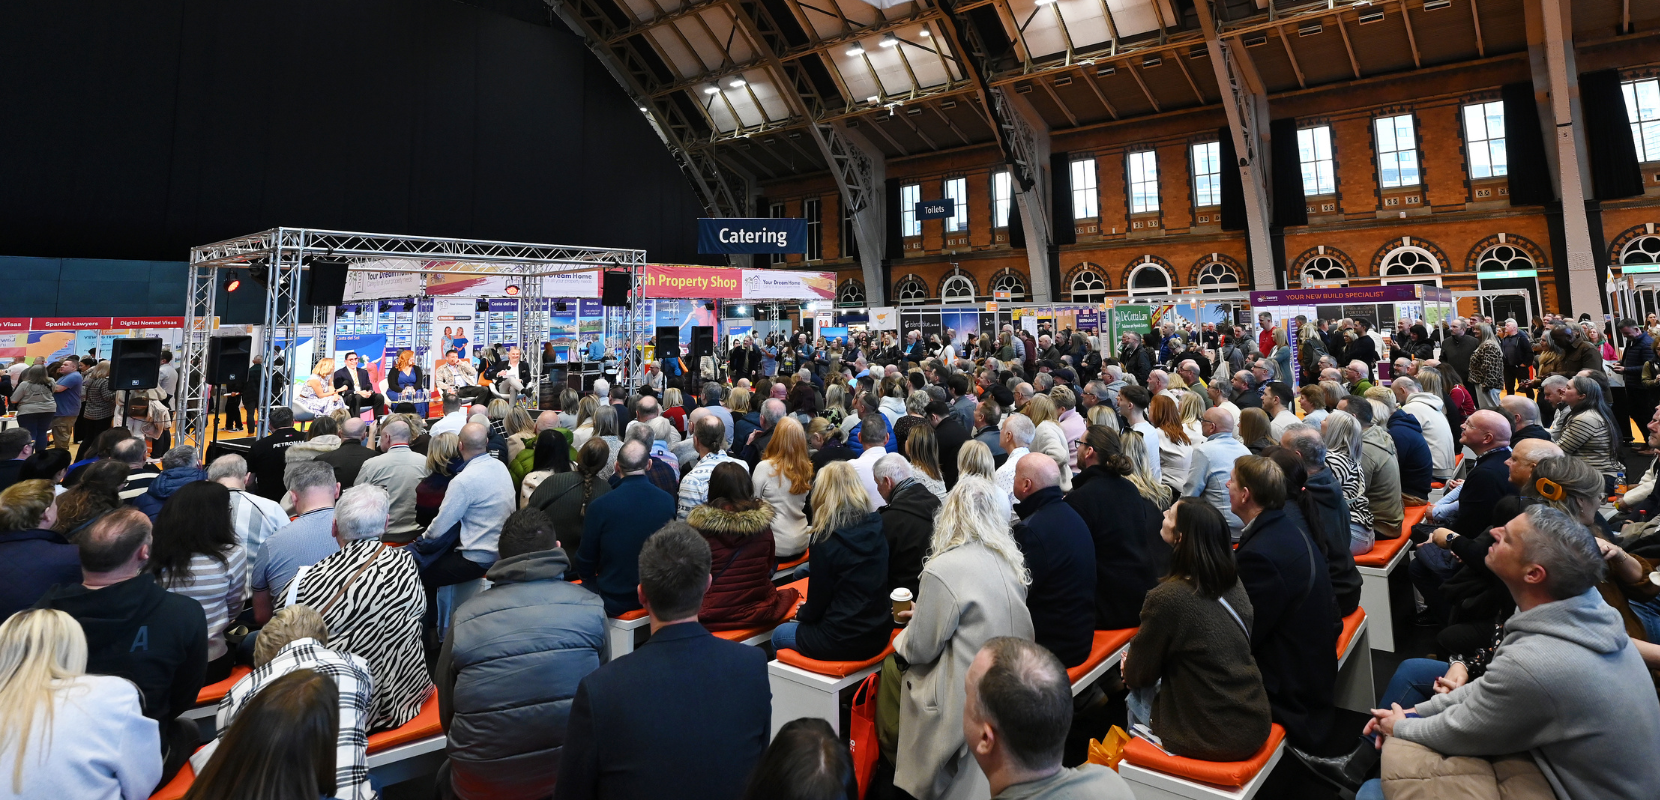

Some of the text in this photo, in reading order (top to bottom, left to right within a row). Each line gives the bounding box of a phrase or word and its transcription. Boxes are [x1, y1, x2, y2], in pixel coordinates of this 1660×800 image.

[924, 206, 945, 214] Toilets
[718, 228, 788, 247] Catering
[658, 274, 708, 290] Property
[710, 276, 737, 290] Shop
[129, 625, 148, 652] A
